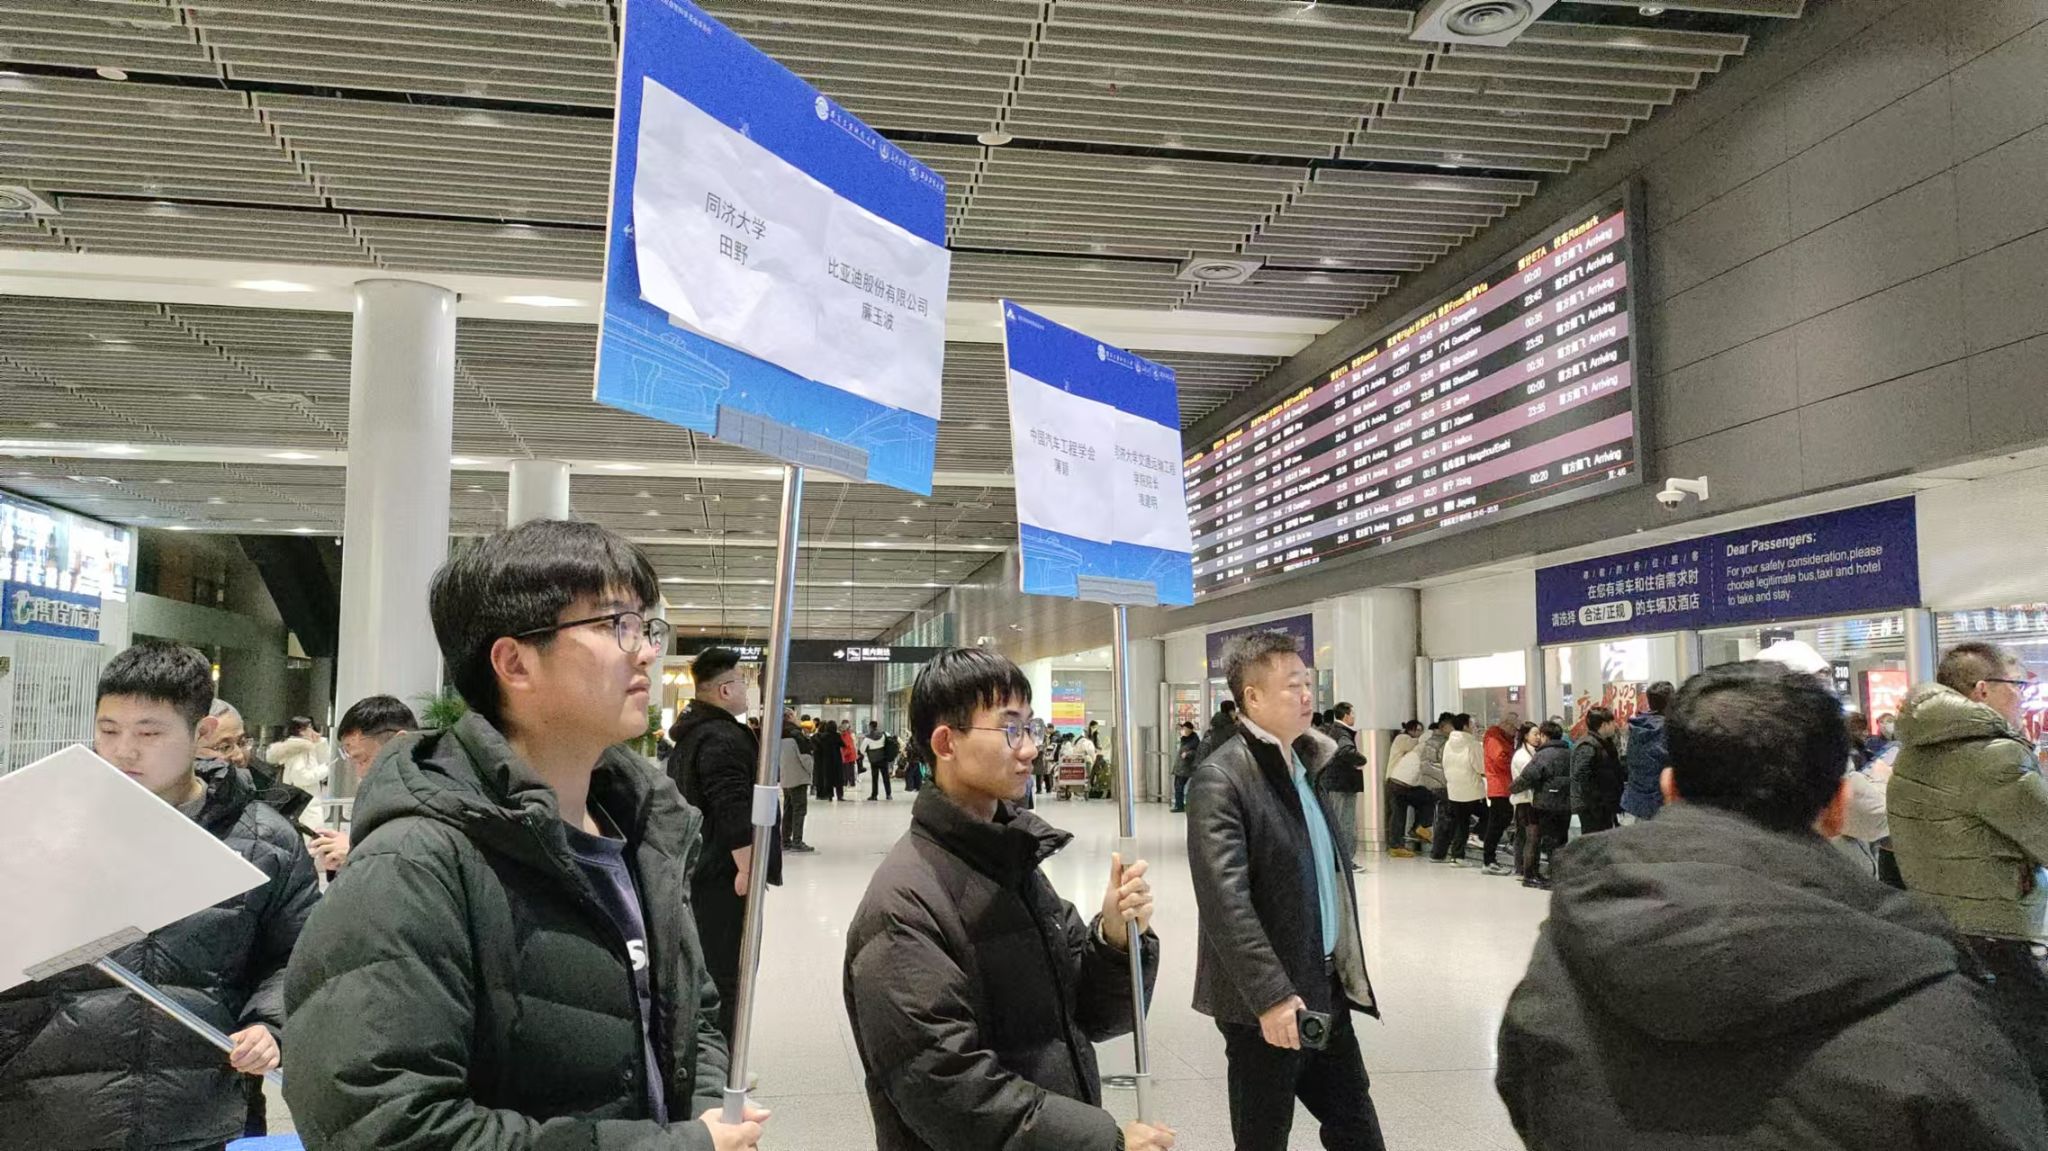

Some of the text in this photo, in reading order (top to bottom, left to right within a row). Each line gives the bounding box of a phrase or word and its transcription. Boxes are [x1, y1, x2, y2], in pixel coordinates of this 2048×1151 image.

[705, 191, 767, 239] 同济大学
[720, 233, 748, 265] 田野
[1585, 228, 1613, 250] Arriving
[1586, 252, 1613, 273] Arriving
[828, 257, 928, 317] 比亚迪股份有限公司
[1587, 277, 1614, 297] Arriving
[1588, 301, 1616, 322] Arriving
[1589, 326, 1617, 345] Arriving
[1527, 379, 1546, 395] 00:00
[1589, 350, 1618, 369] Arriving
[1591, 375, 1618, 393] Arriving
[1030, 427, 1096, 461] 中国汽车工程学会
[1530, 470, 1549, 485] 00:20
[1593, 449, 1622, 466] Arriving
[1726, 532, 1817, 557] Dear Passengers:
[1726, 566, 1740, 577] For
[1741, 564, 1759, 578] your
[1760, 559, 1785, 573] safety
[1727, 559, 1882, 592] choose legitimate bus,taxi and hotel
[1588, 567, 1699, 599] 在您有乘车和住宿需求时
[1551, 592, 1700, 627] 请选择 合法/正规 的车辆及酒店
[1727, 596, 1736, 606] to
[1737, 592, 1753, 604] take
[1755, 589, 1771, 601] and
[1835, 666, 1849, 679] 310
